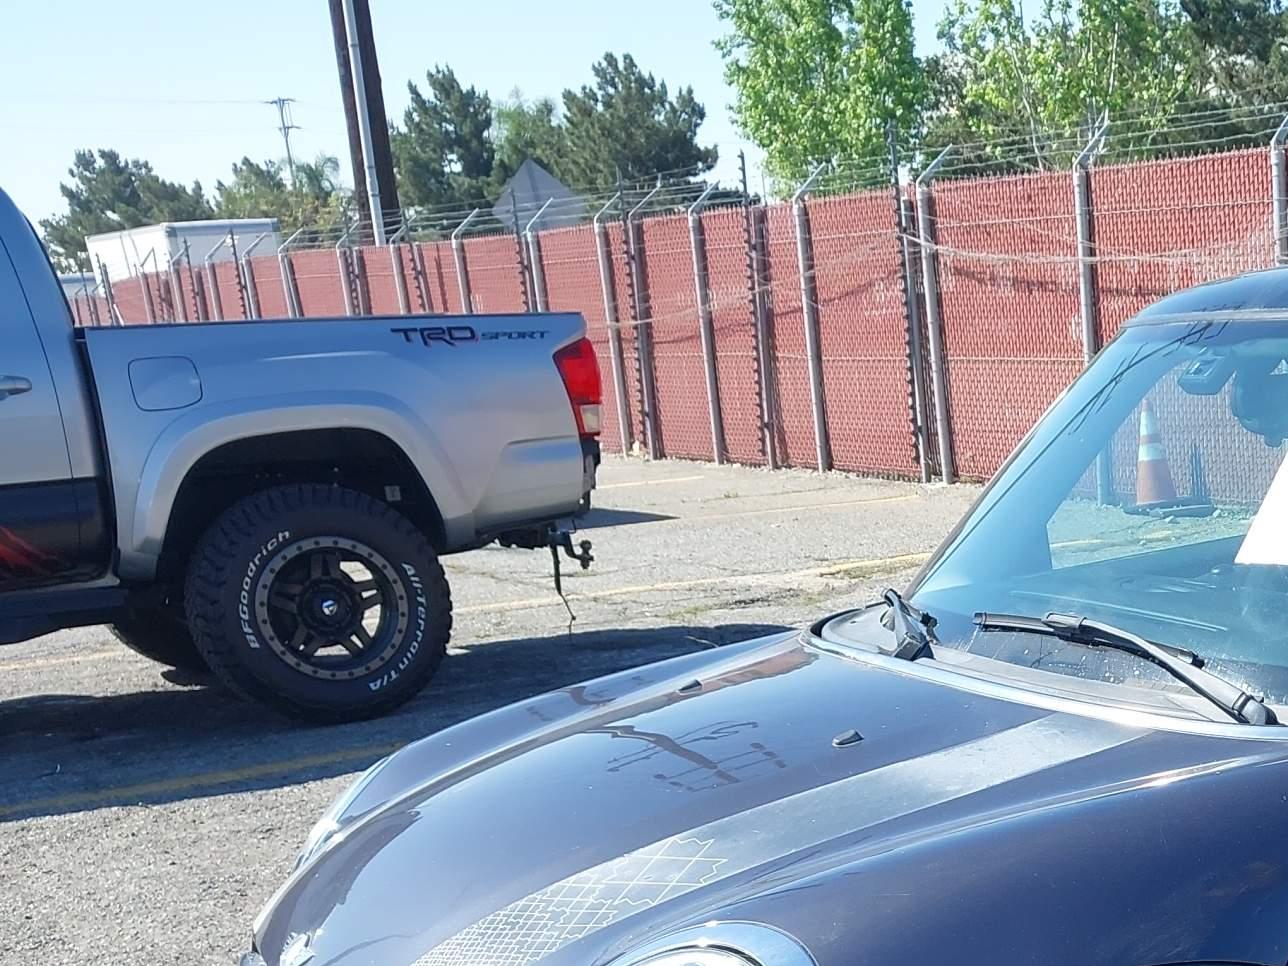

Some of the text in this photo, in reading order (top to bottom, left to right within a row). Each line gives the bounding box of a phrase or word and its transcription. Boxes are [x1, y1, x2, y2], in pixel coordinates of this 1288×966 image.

[390, 326, 550, 347] TRD SPORT
[238, 529, 428, 691] BFGoodrich All-Terrain T/A
